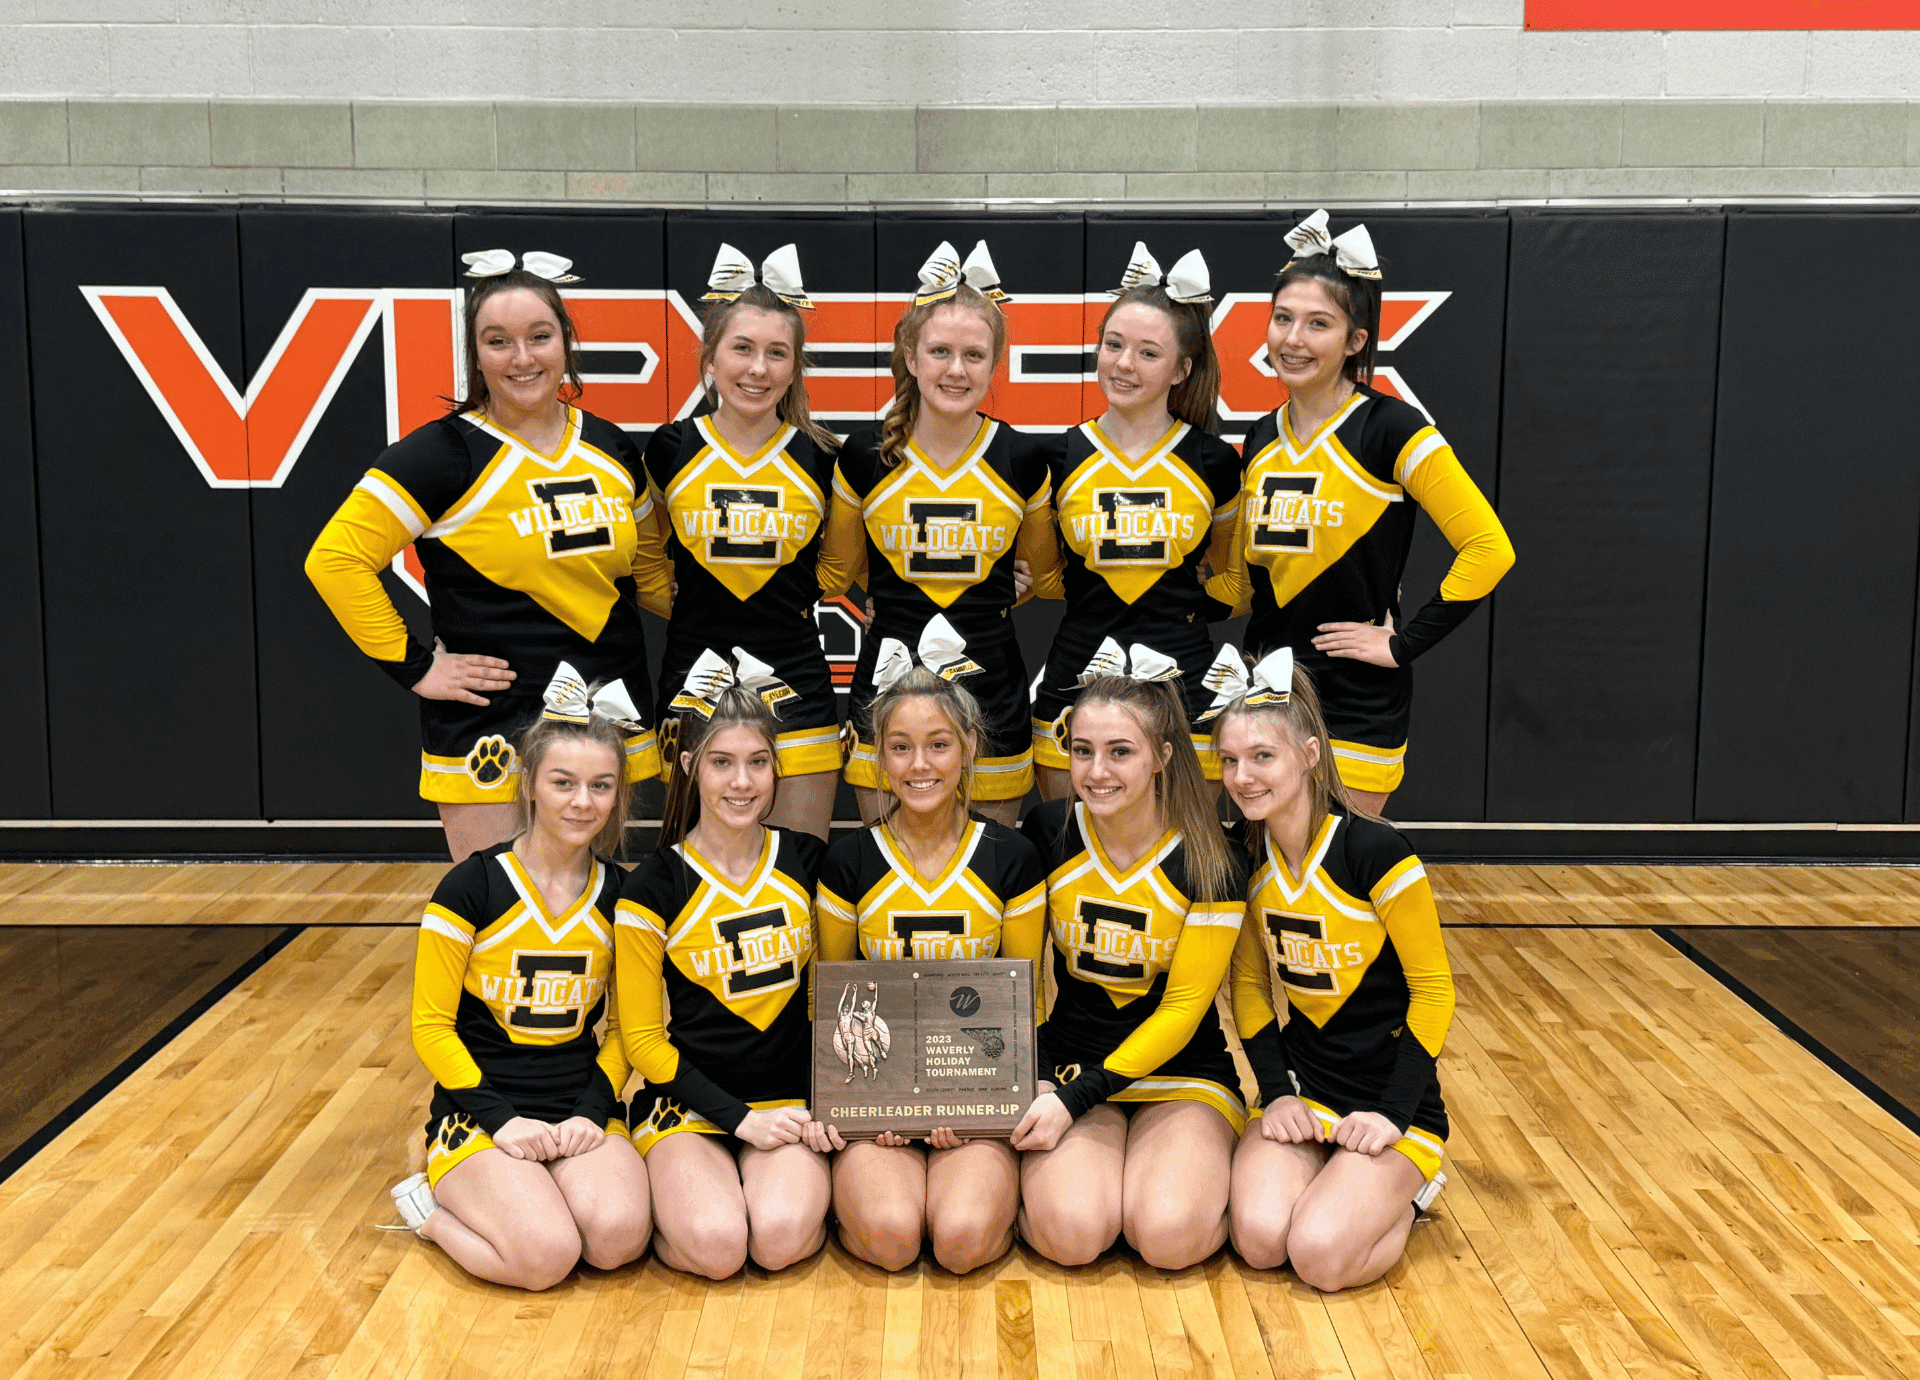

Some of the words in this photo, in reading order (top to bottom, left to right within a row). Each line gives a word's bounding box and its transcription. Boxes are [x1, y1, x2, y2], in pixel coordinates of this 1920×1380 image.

[507, 497, 629, 538] WILDCATS
[682, 510, 808, 540] WILDCATS
[1071, 512, 1195, 542] WILDCATS
[881, 524, 1006, 551] WILDCATS
[689, 923, 812, 977] WILDCATS
[866, 934, 995, 960] WILDCATS
[1053, 916, 1178, 961] WILDCATS
[481, 974, 607, 1006] WILDCATS
[926, 1035, 952, 1044] 2023
[926, 1045, 974, 1055] WAVERLY
[926, 1056, 971, 1066] HOLIDAY
[926, 1067, 997, 1077] TOURNAMENT
[831, 1105, 932, 1118] CHEERLEADER
[936, 1104, 1020, 1116] RUNNER-UP
